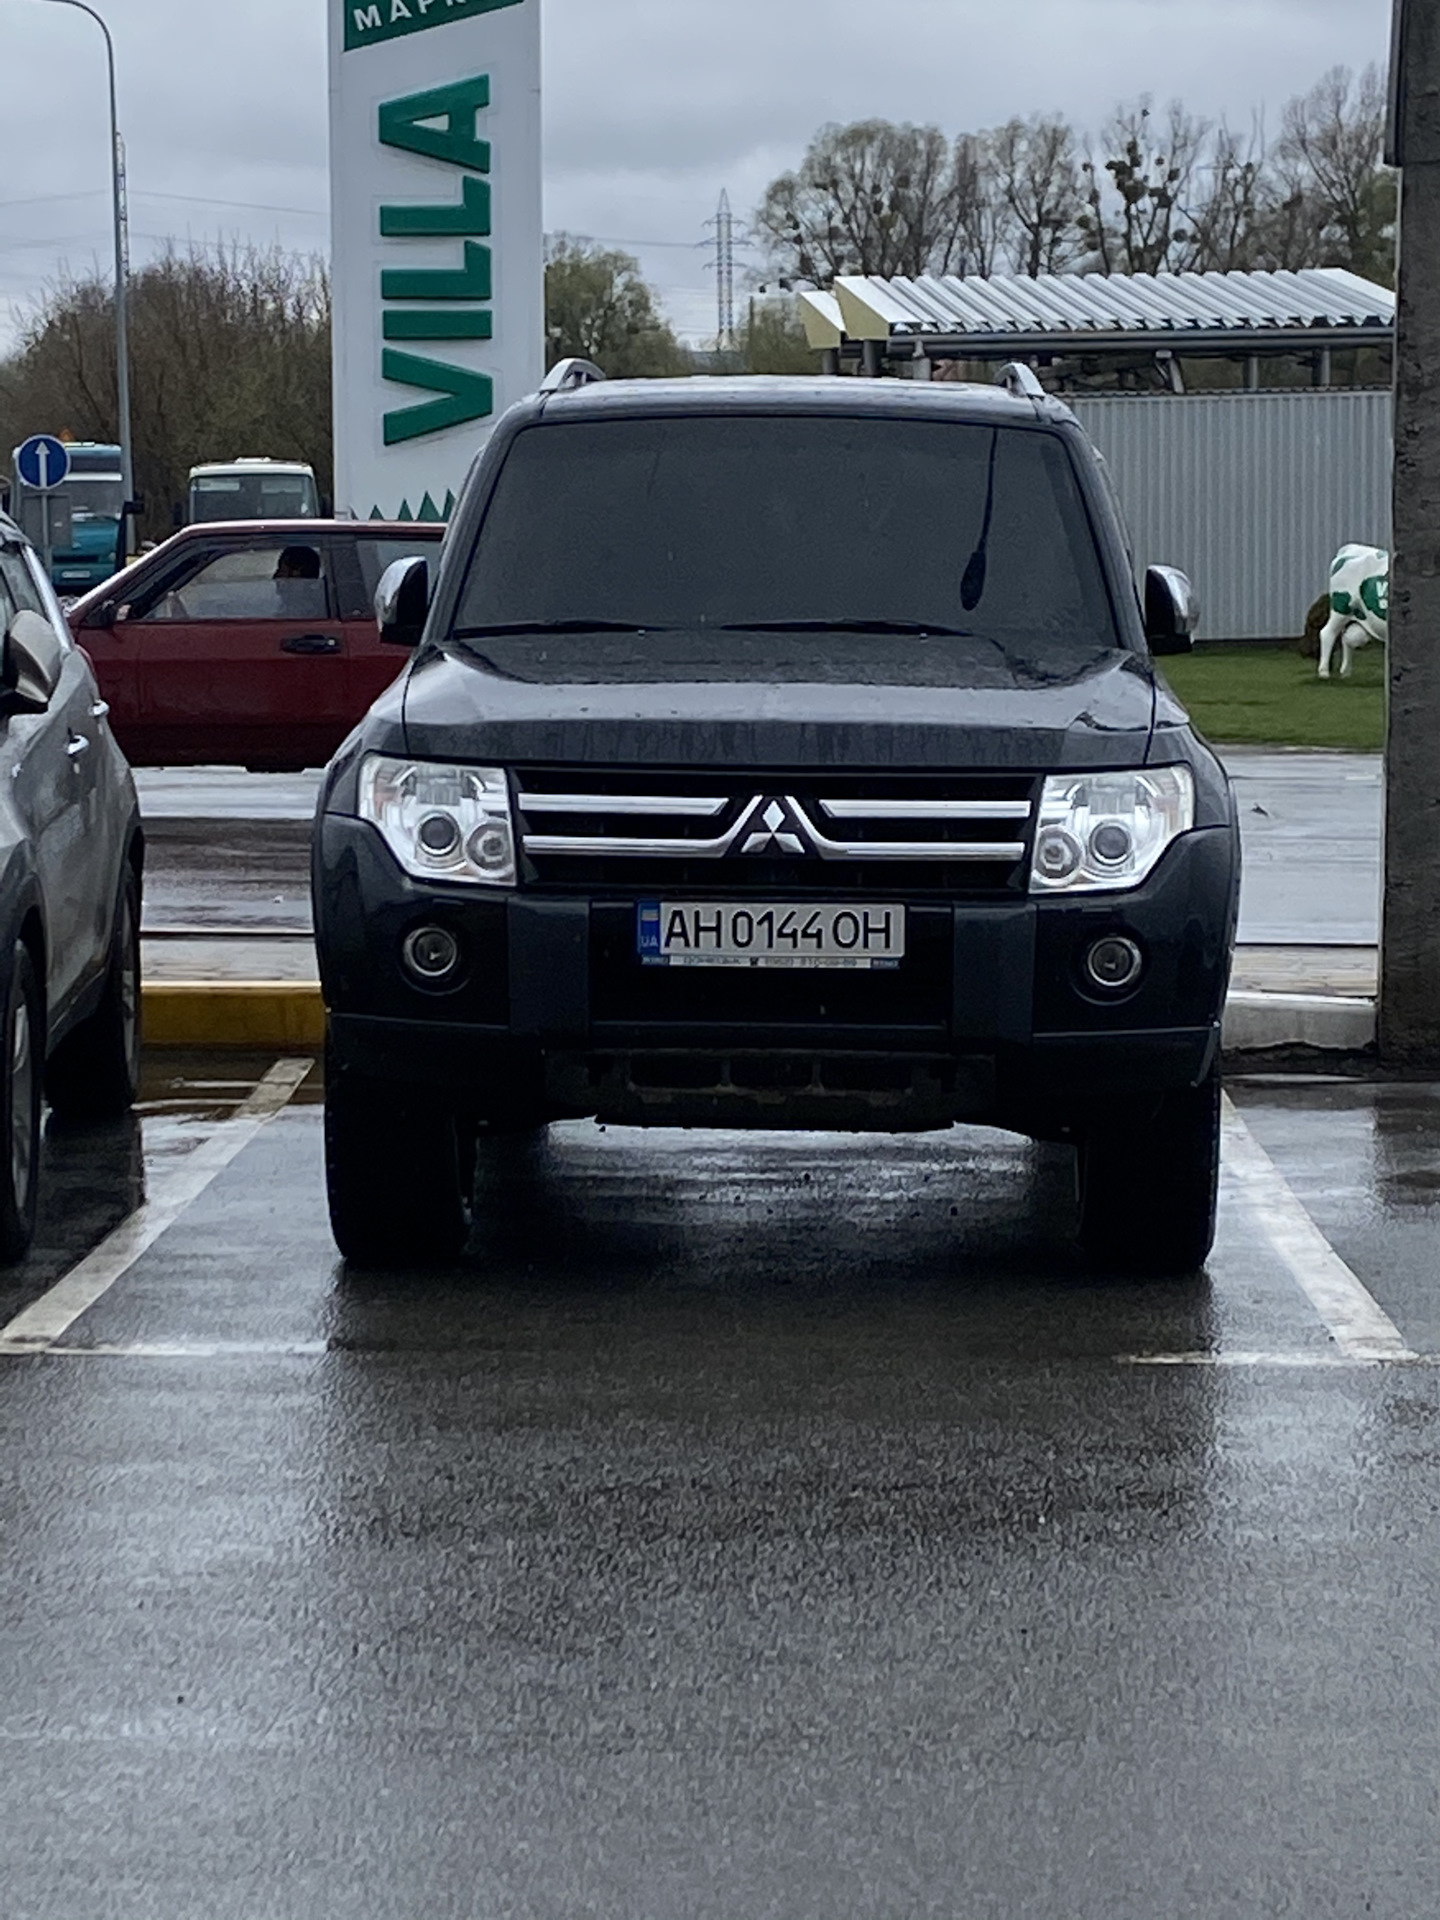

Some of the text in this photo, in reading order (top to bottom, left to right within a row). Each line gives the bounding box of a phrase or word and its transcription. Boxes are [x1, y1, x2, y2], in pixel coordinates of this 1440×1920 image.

[353, 0, 466, 31] МАР
[378, 73, 493, 446] VILLA
[664, 910, 891, 949] AH 0144 OH
